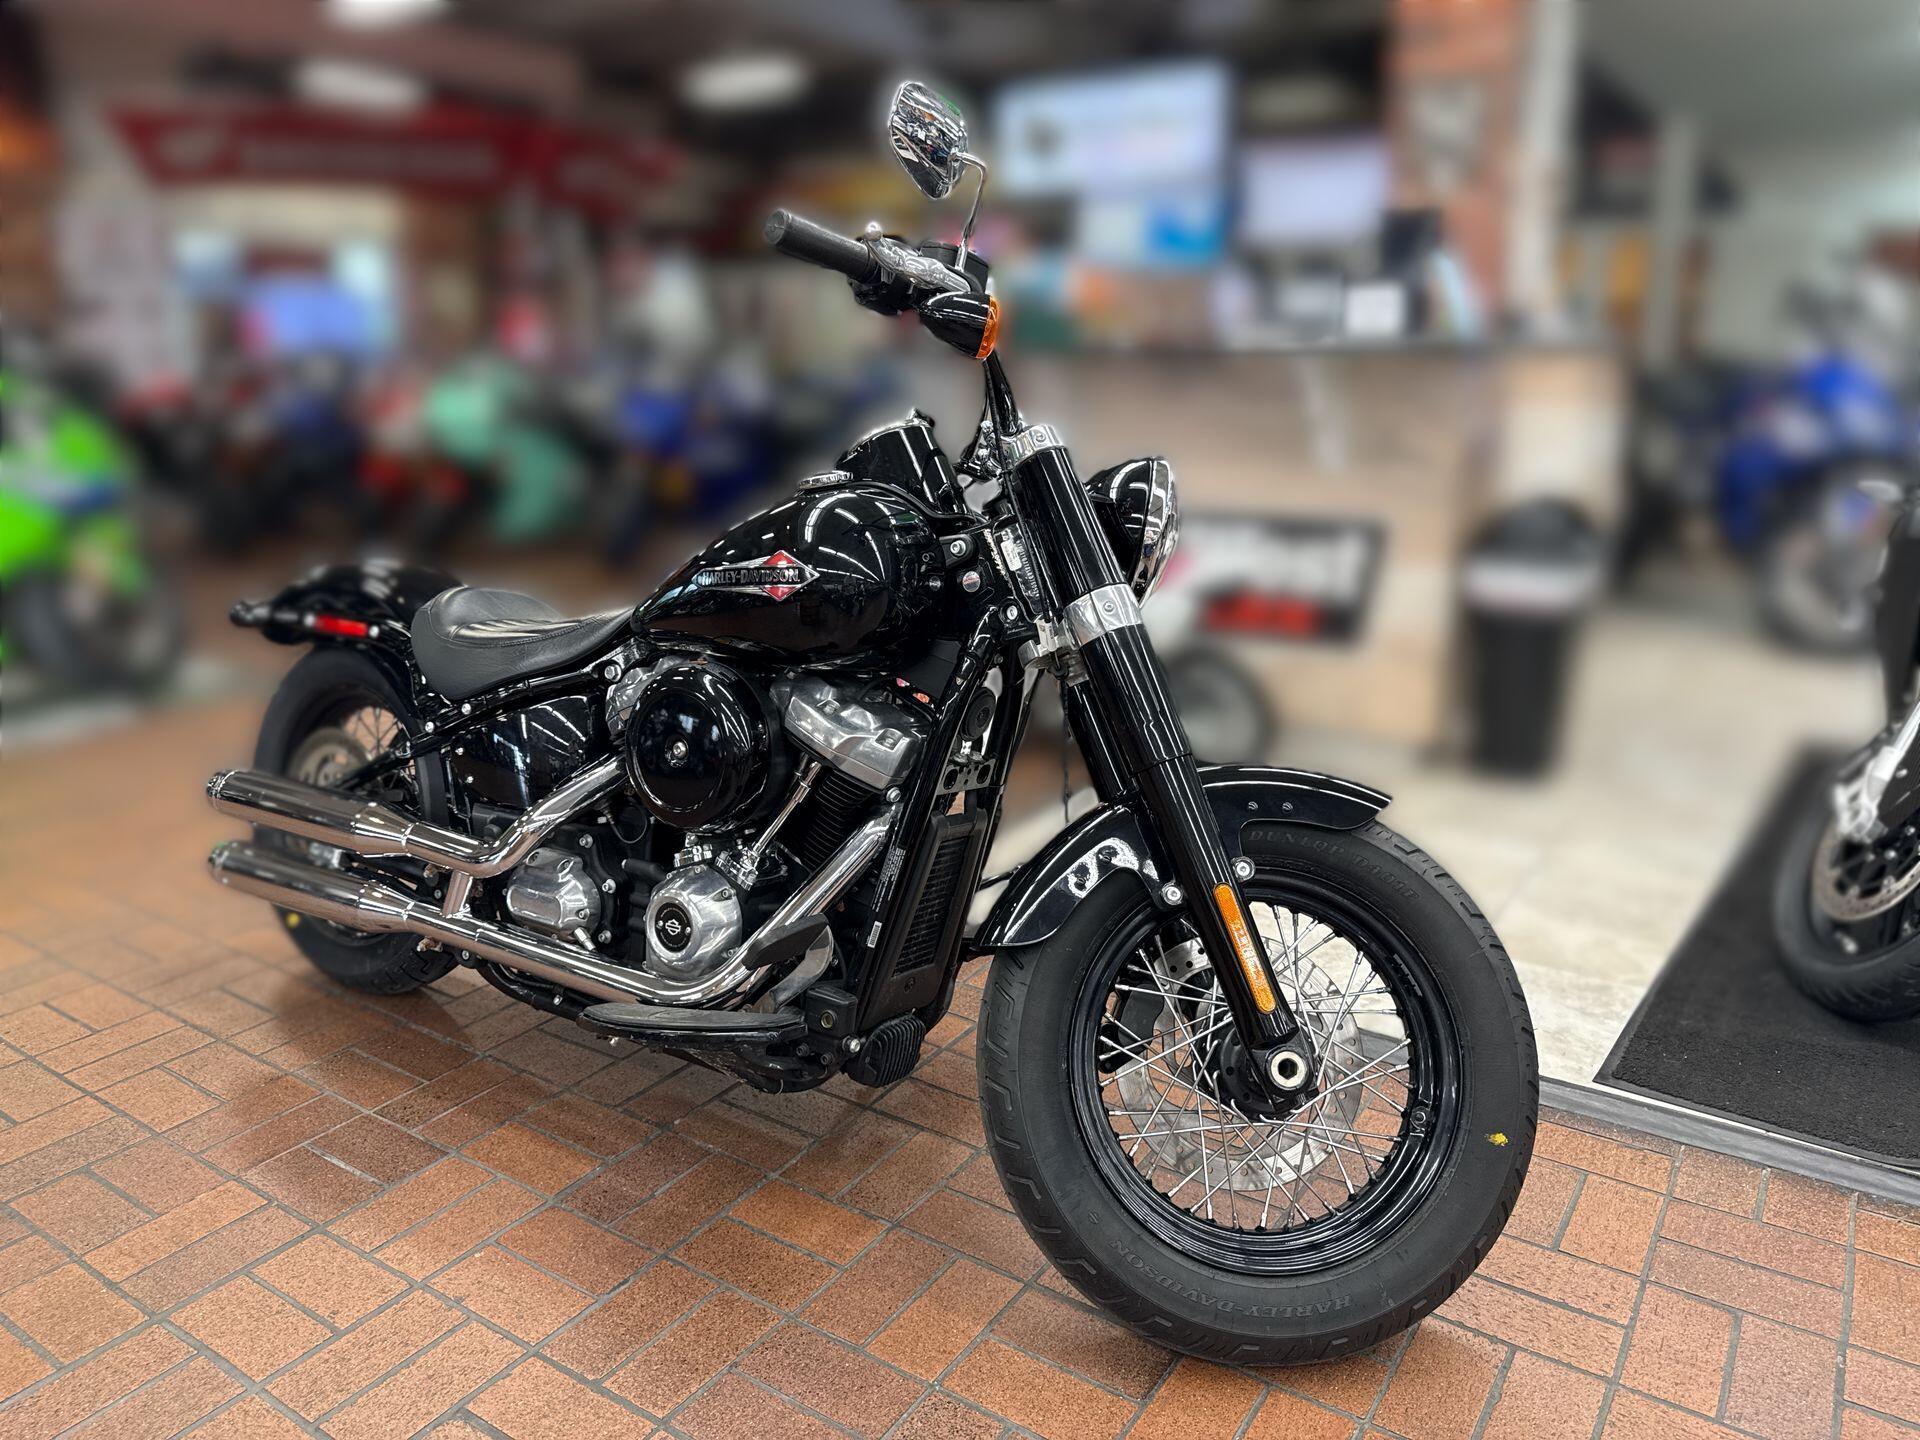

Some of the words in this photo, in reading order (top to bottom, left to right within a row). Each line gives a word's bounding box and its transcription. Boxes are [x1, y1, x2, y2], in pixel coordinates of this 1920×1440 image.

[700, 568, 800, 586] HARLEY-DAVIDSON
[1248, 830, 1345, 855] DUNLOP
[1108, 1239, 1352, 1318] HARLEY-DAVIDSON
